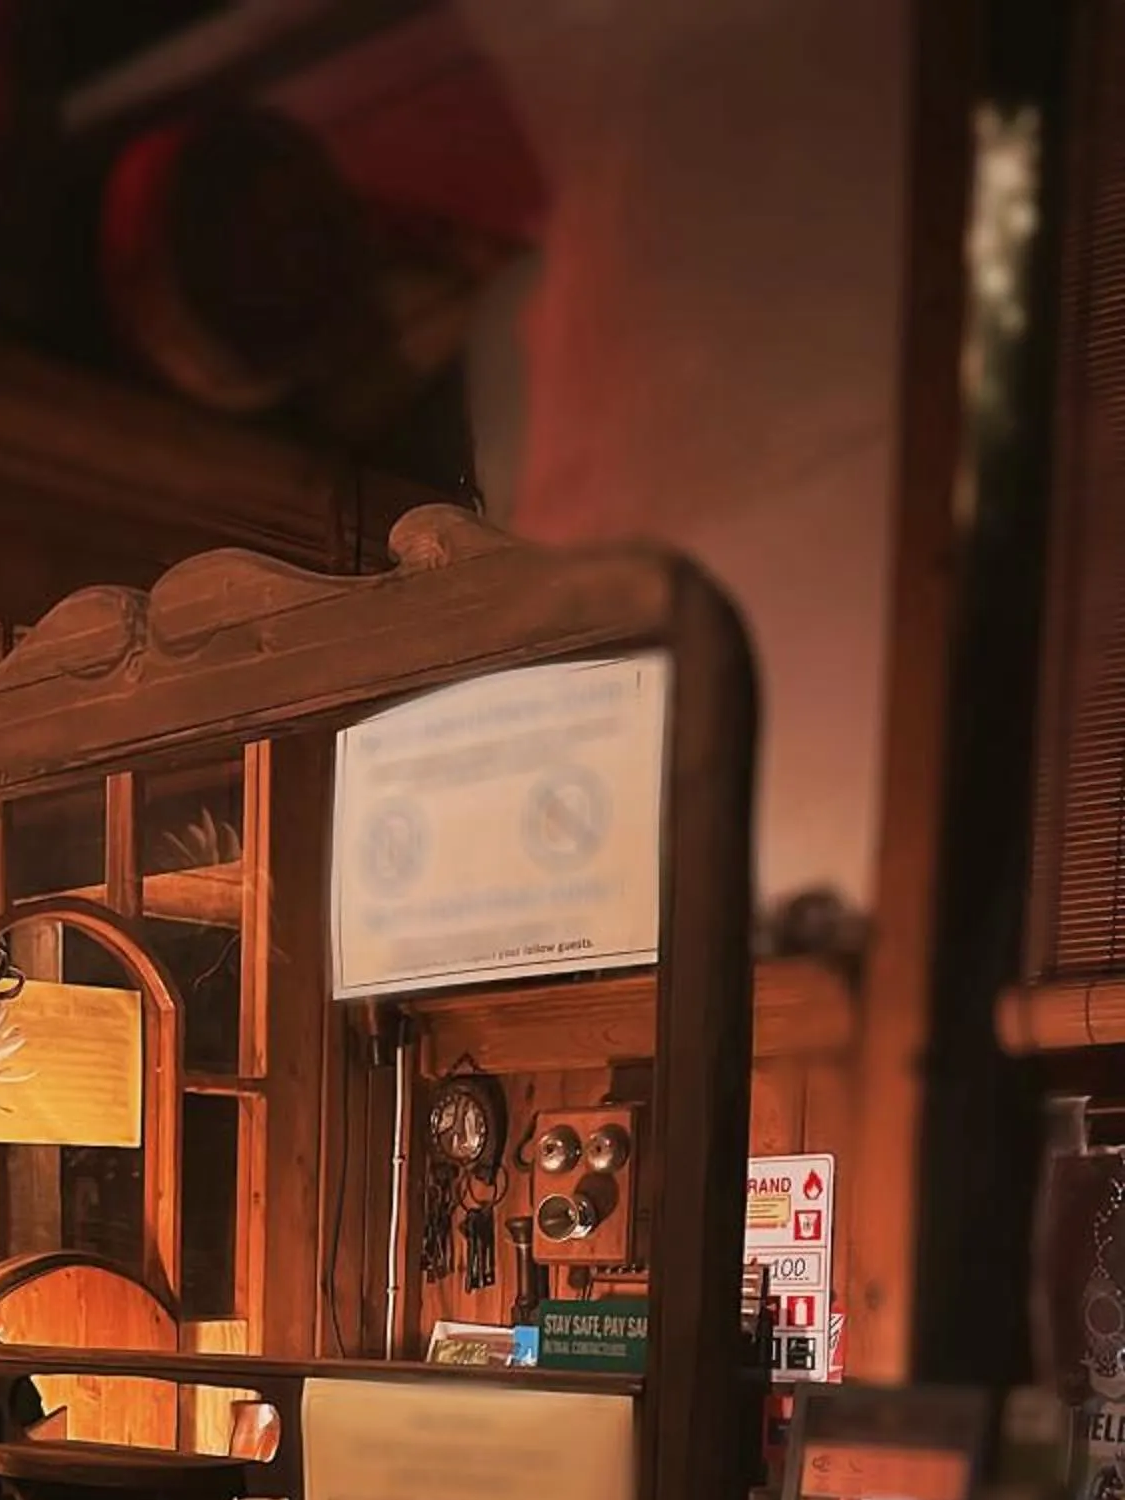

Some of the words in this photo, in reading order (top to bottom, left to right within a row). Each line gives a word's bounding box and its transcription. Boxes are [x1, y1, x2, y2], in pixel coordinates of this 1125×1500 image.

[748, 1177, 792, 1196] RAND
[544, 1313, 572, 1336] STAY
[603, 1315, 626, 1338] PAY
